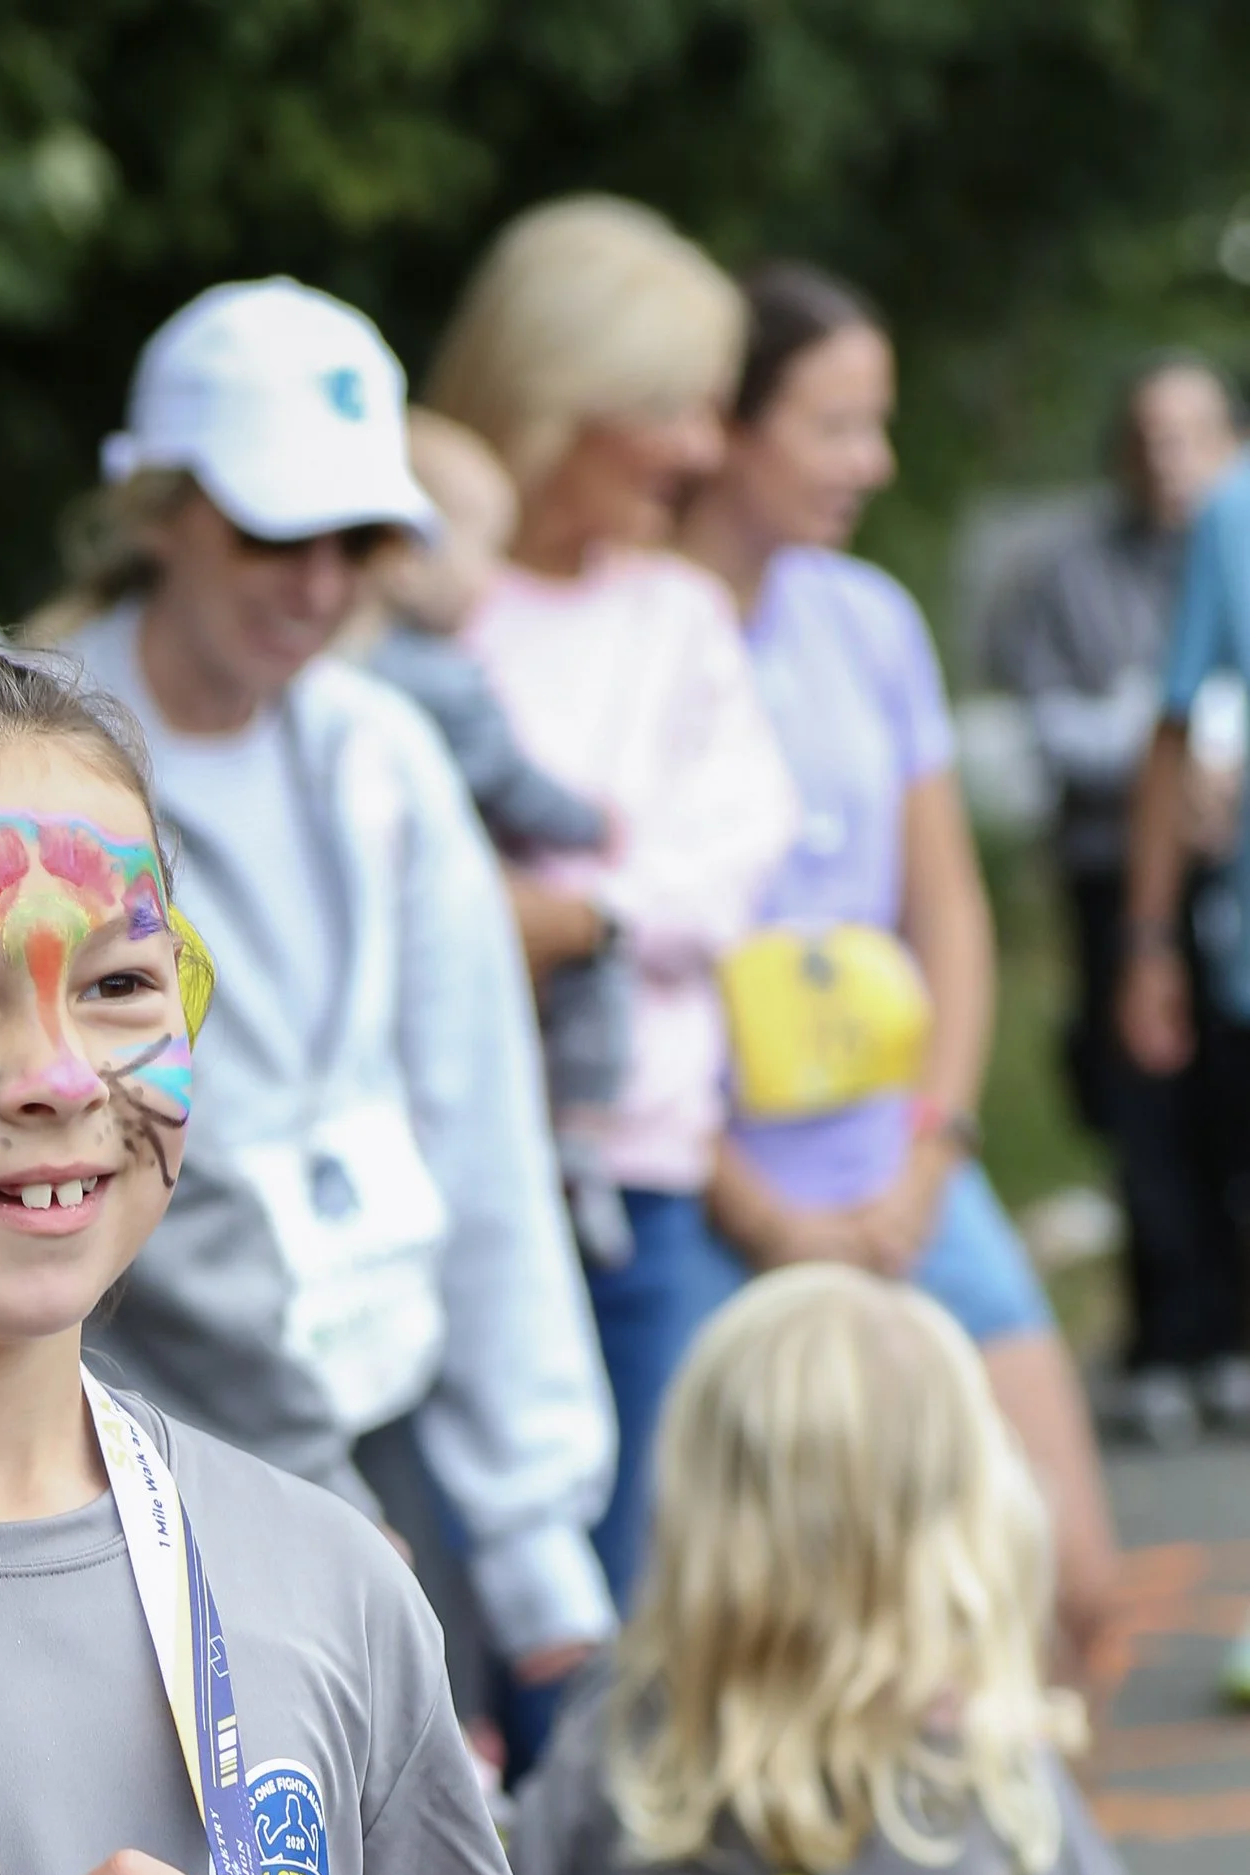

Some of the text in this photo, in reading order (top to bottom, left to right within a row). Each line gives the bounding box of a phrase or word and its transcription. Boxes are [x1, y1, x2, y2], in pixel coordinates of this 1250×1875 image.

[136, 1454, 158, 1491] Walk
[152, 1499, 169, 1537] Mile
[159, 1540, 171, 1548] 1
[255, 1779, 277, 1802] ONE
[276, 1776, 308, 1796] FIGHTS
[285, 1835, 305, 1851] 2026
